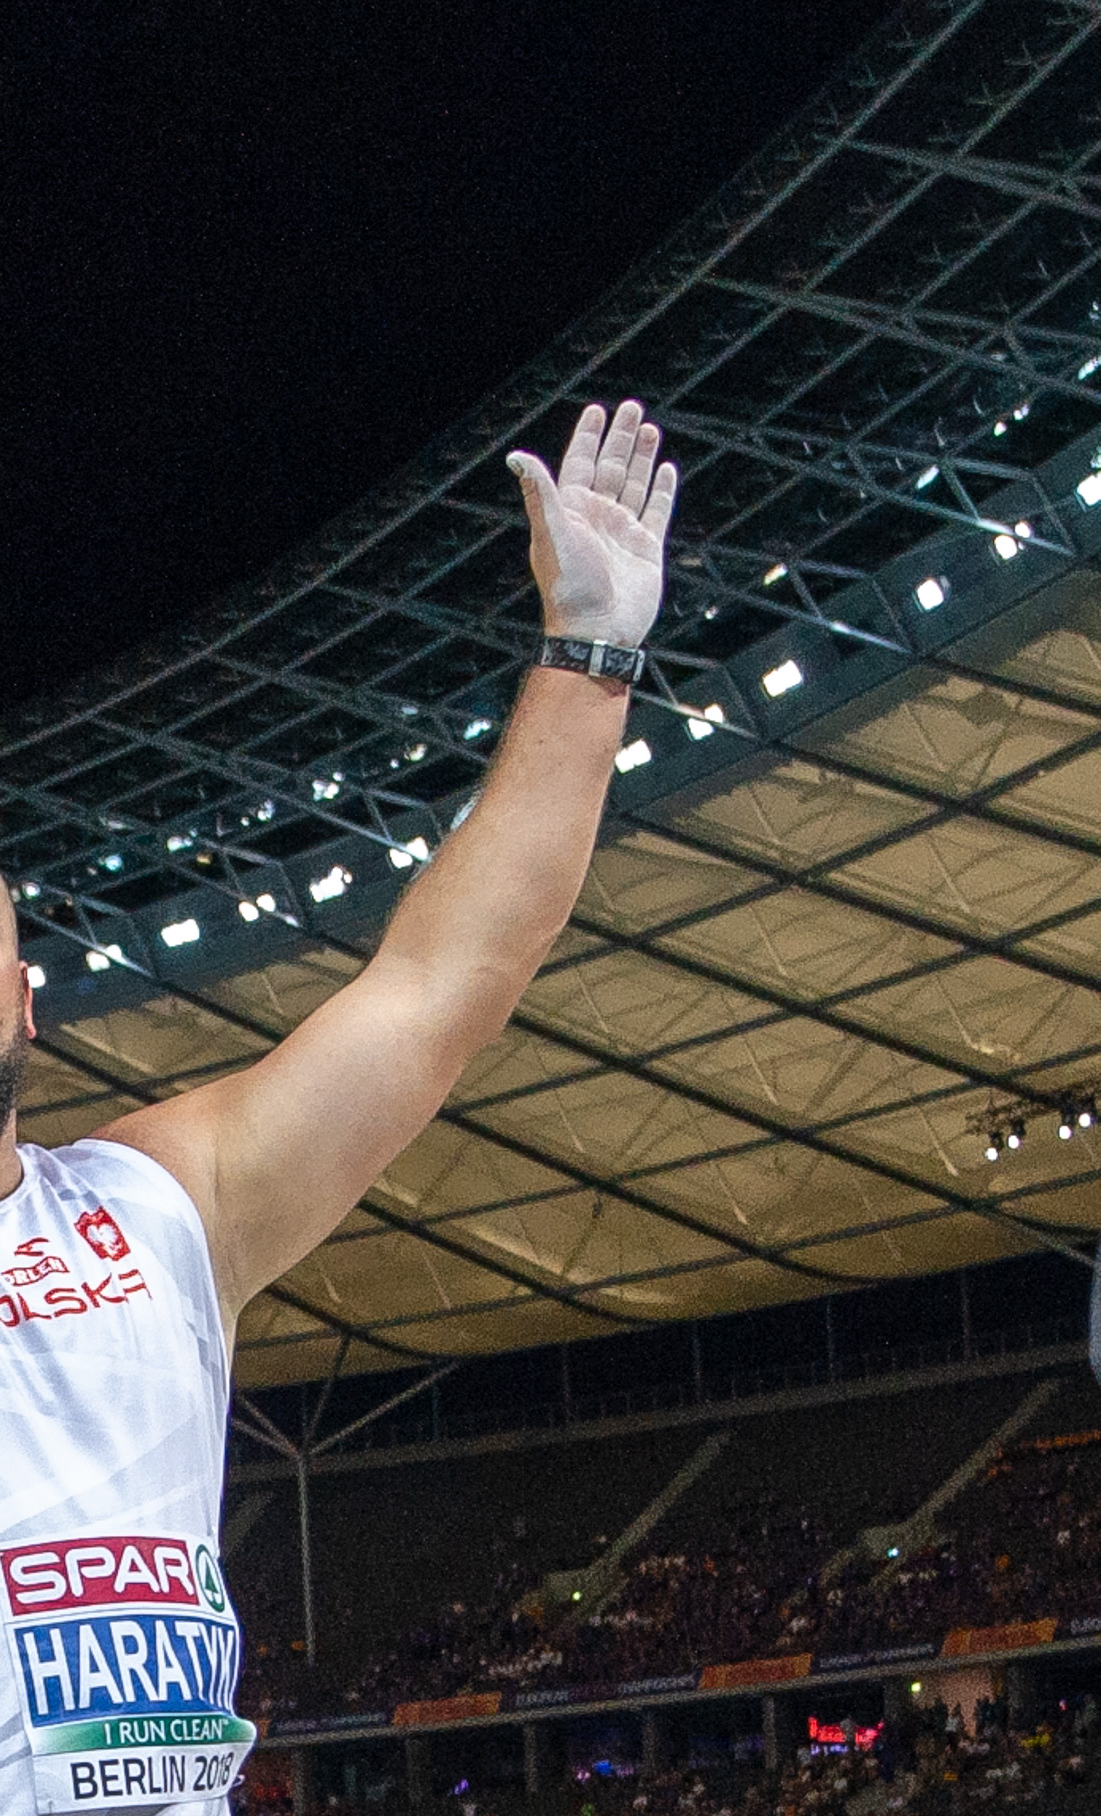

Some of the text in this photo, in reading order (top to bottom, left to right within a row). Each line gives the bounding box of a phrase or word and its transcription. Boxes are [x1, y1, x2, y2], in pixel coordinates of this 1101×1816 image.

[9, 1545, 196, 1604] SPAR
[104, 1723, 112, 1745] I
[119, 1720, 166, 1744] RUN
[70, 1752, 234, 1800] BERLIN 2018
